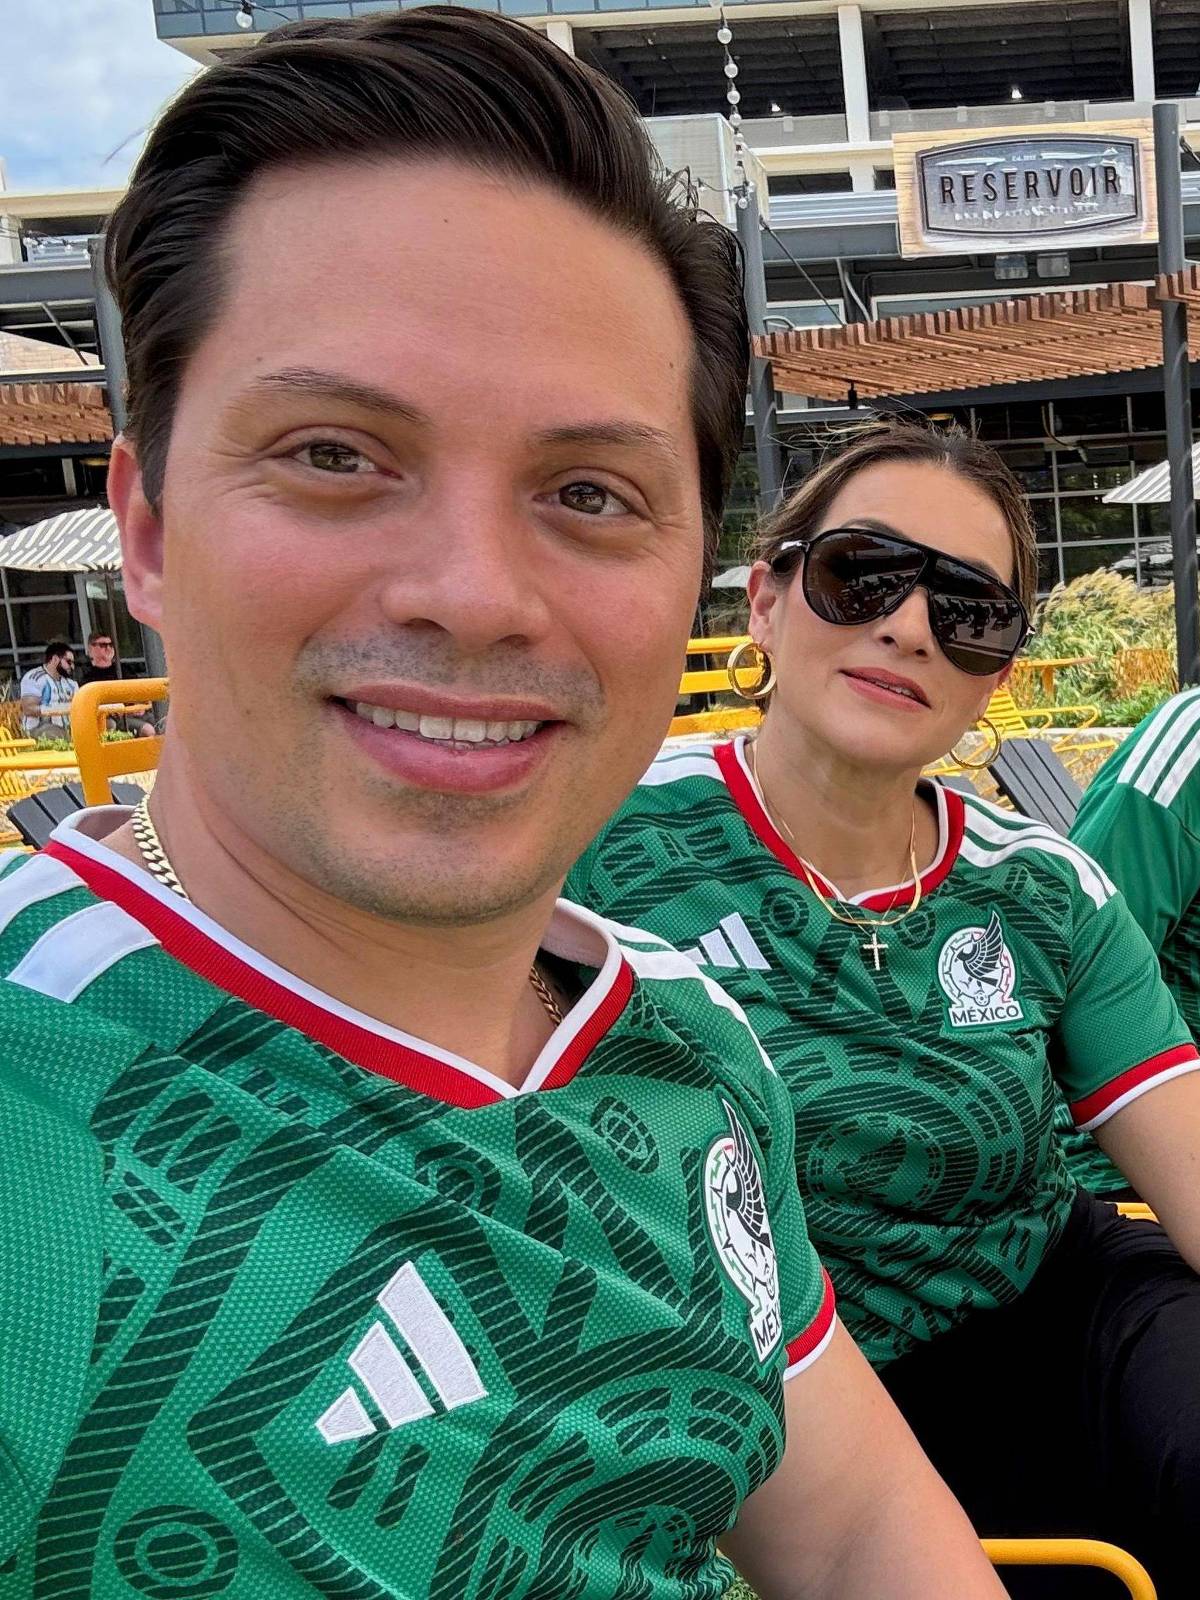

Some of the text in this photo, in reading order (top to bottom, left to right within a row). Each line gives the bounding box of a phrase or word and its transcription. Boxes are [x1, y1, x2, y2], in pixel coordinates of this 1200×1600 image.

[939, 165, 1120, 204] RESERVOIR
[951, 1005, 1019, 1025] MÉXICO
[753, 1302, 781, 1355] MÉX
